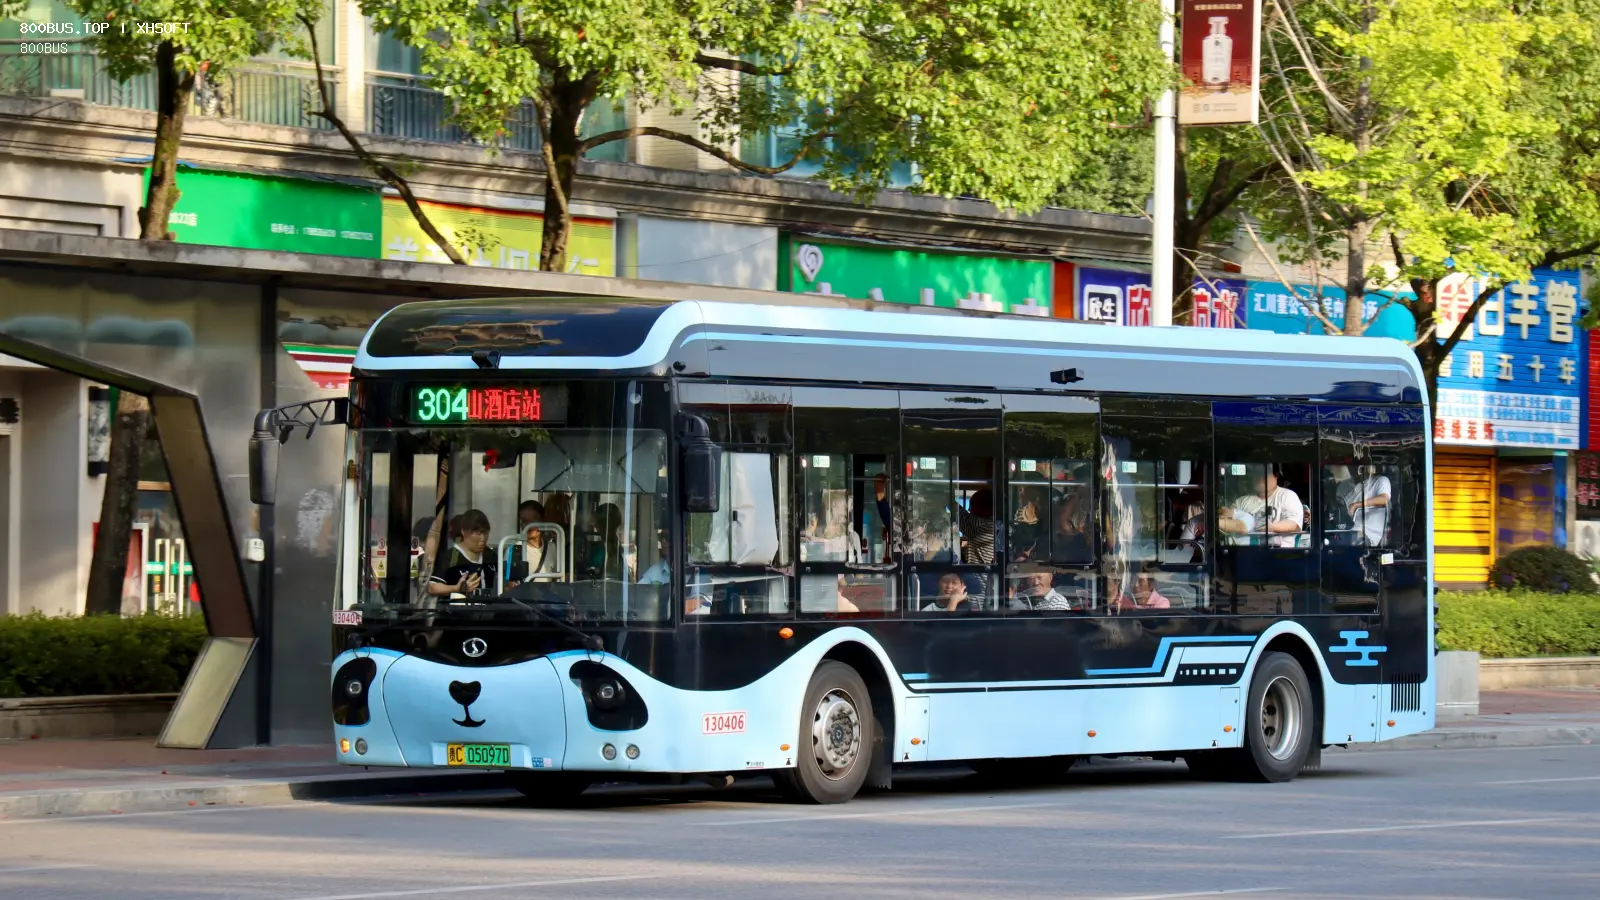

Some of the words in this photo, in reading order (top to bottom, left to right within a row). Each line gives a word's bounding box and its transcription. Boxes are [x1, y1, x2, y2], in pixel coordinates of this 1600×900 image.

[1088, 297, 1117, 321] 欣生
[418, 388, 467, 421] 304
[468, 389, 541, 421] 山酒店站
[703, 713, 745, 732] 130406
[449, 747, 463, 762] 贵C
[468, 747, 509, 763] 05097D
